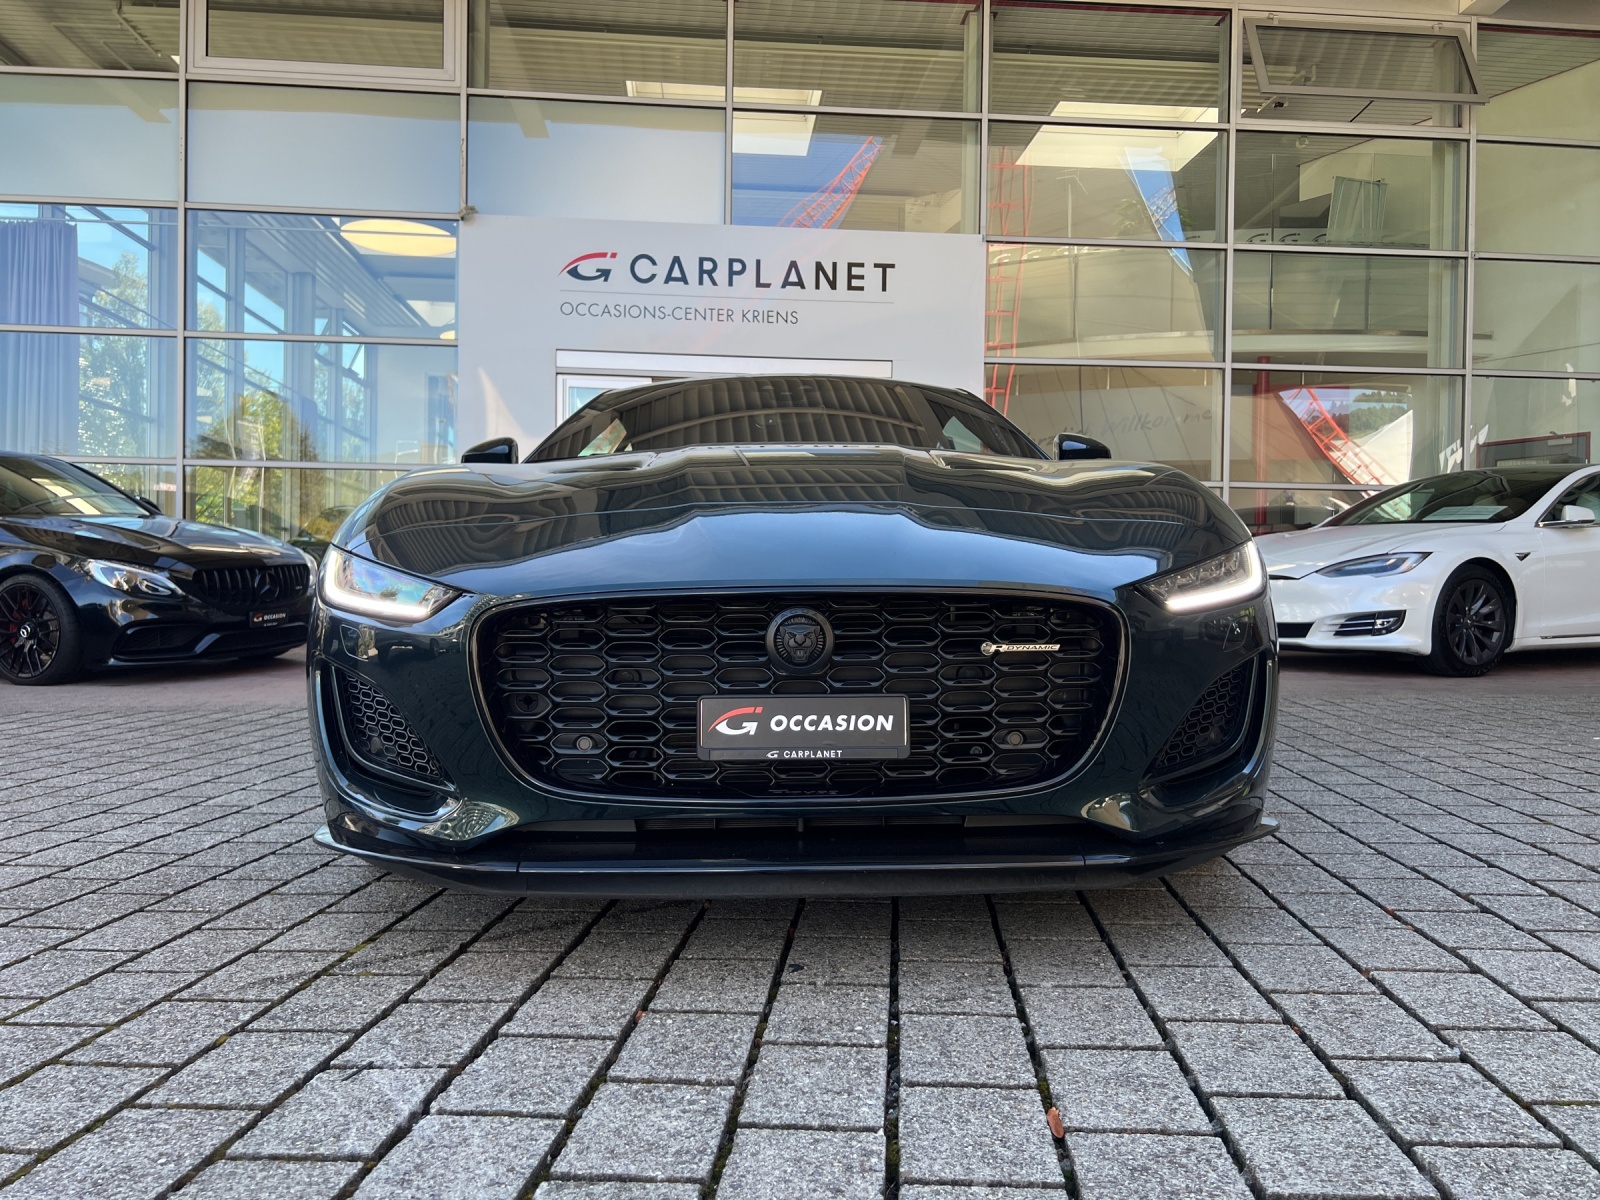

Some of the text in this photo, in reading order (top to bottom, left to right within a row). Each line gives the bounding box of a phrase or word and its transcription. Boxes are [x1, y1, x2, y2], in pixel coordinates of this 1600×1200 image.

[630, 254, 896, 293] CARPLANET
[560, 301, 799, 325] OCCASIONS-CENTER KRIENS
[769, 714, 894, 732] OCCASION
[783, 750, 843, 759] CARPLANET
